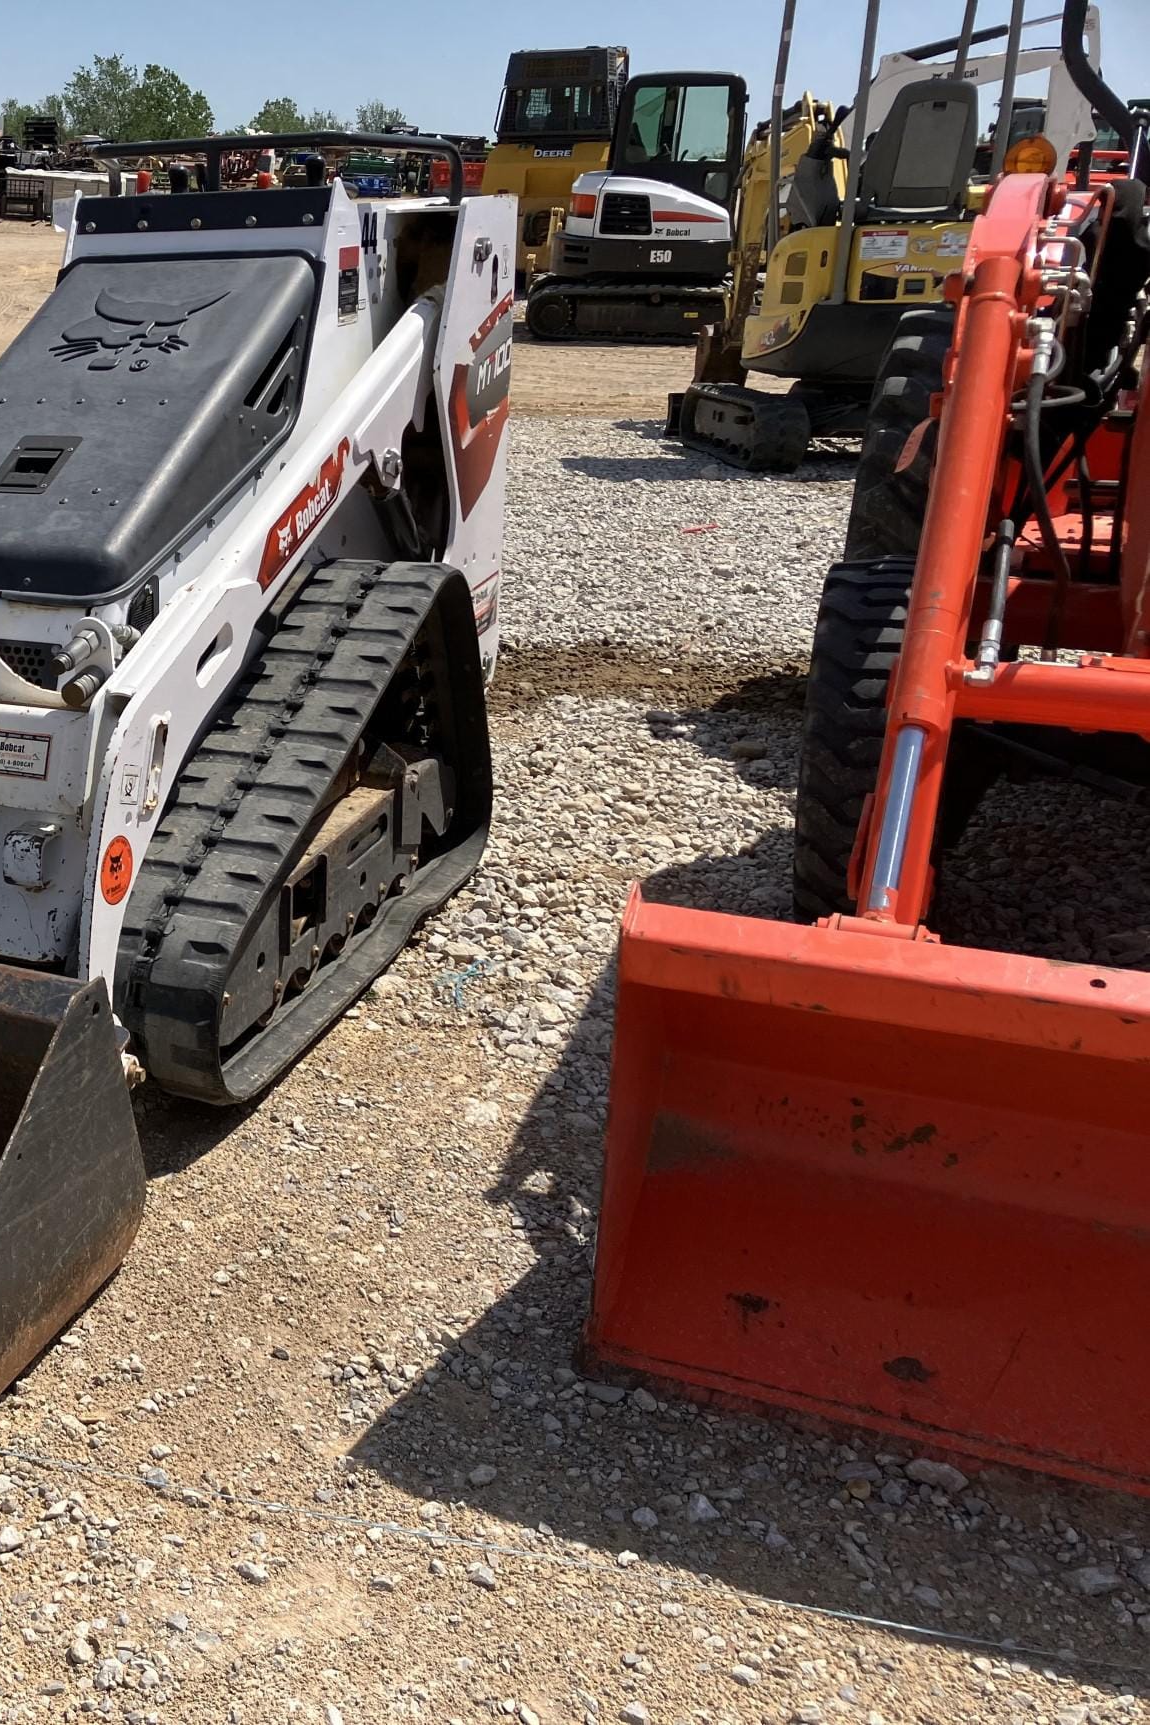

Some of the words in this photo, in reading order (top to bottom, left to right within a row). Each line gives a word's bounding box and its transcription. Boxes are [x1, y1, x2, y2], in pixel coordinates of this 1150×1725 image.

[947, 68, 978, 80] Bcat
[534, 149, 572, 158] DEERE
[666, 228, 691, 237] Bobcat
[650, 250, 673, 263] E50
[477, 337, 512, 395] MT100
[295, 479, 332, 539] Bobcat
[0, 742, 25, 753] Bobcat
